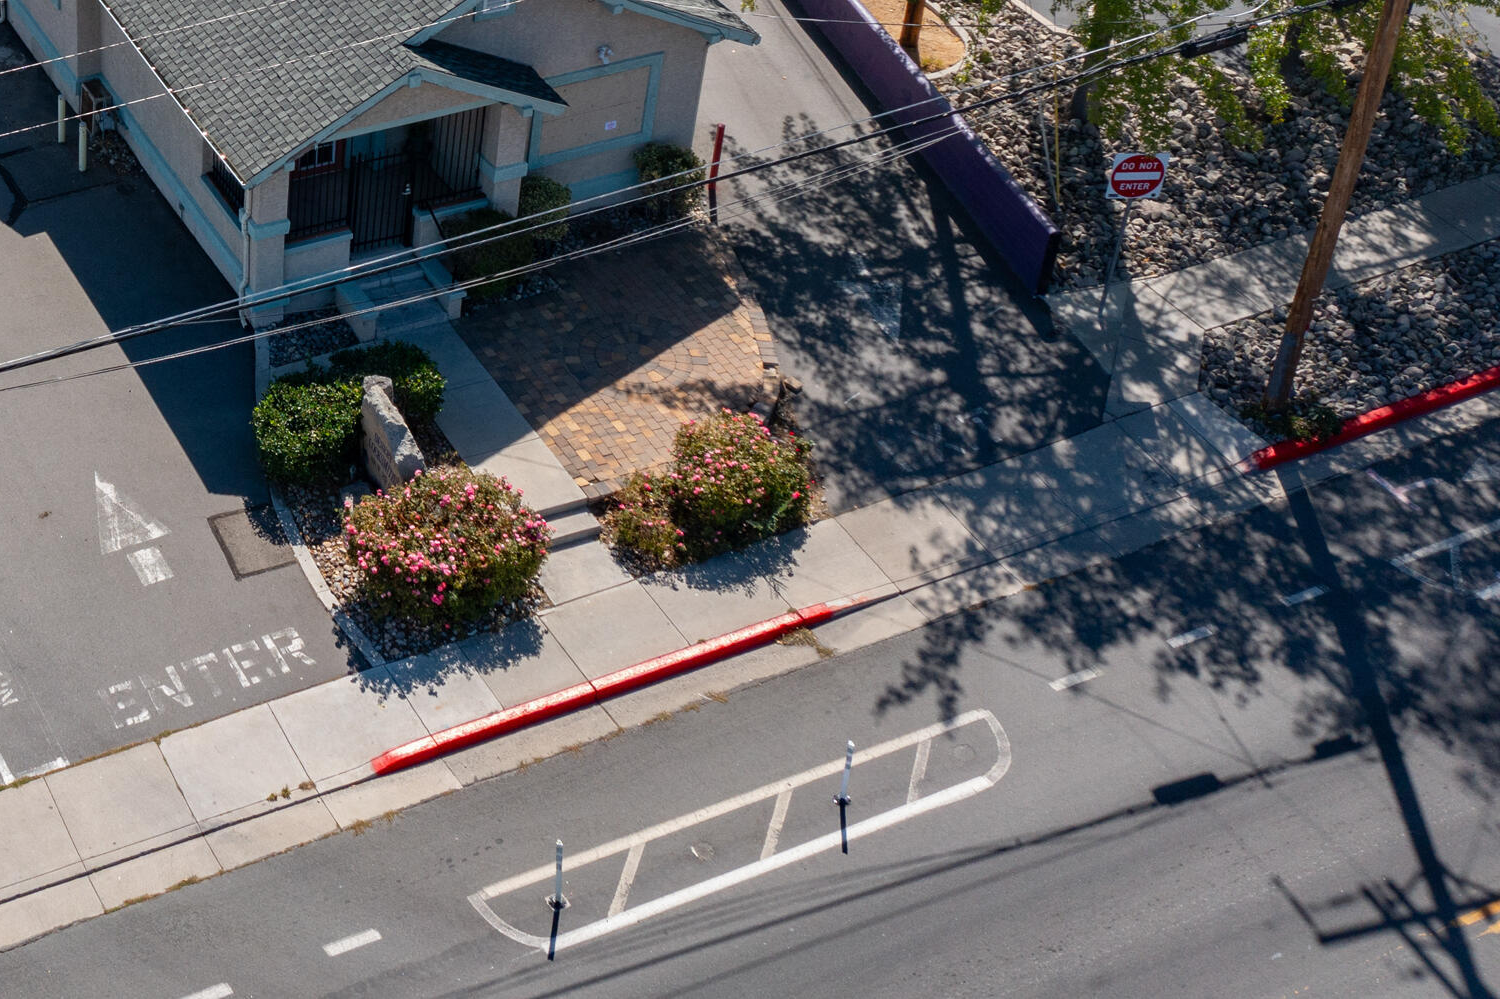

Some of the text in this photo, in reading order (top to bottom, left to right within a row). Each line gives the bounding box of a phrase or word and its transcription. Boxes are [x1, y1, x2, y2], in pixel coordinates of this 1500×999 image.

[1121, 162, 1159, 170] DO NOT
[99, 626, 316, 729] ENTER
